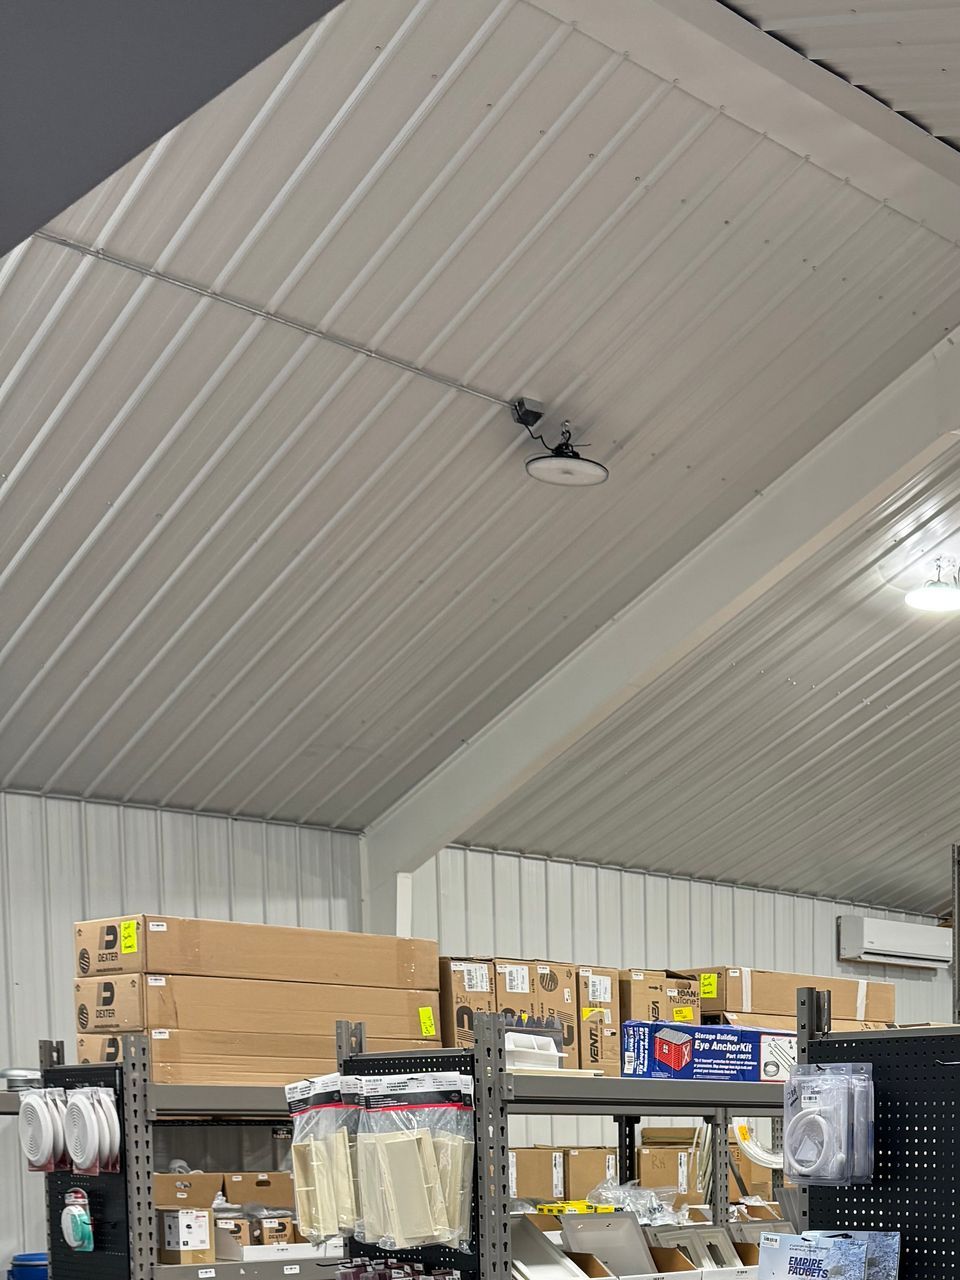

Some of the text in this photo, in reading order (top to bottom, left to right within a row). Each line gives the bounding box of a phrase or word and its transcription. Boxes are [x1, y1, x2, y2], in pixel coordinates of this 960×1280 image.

[98, 952, 118, 962] DEXTER
[669, 996, 697, 1006] NuTone
[96, 1008, 115, 1019] DEXTER
[694, 1031, 738, 1042] Storage Building
[694, 1040, 710, 1051] Eye
[268, 1232, 288, 1240] DEXTER
[788, 1256, 824, 1268] EMPIRE
[787, 1266, 829, 1279] FAUCETS
